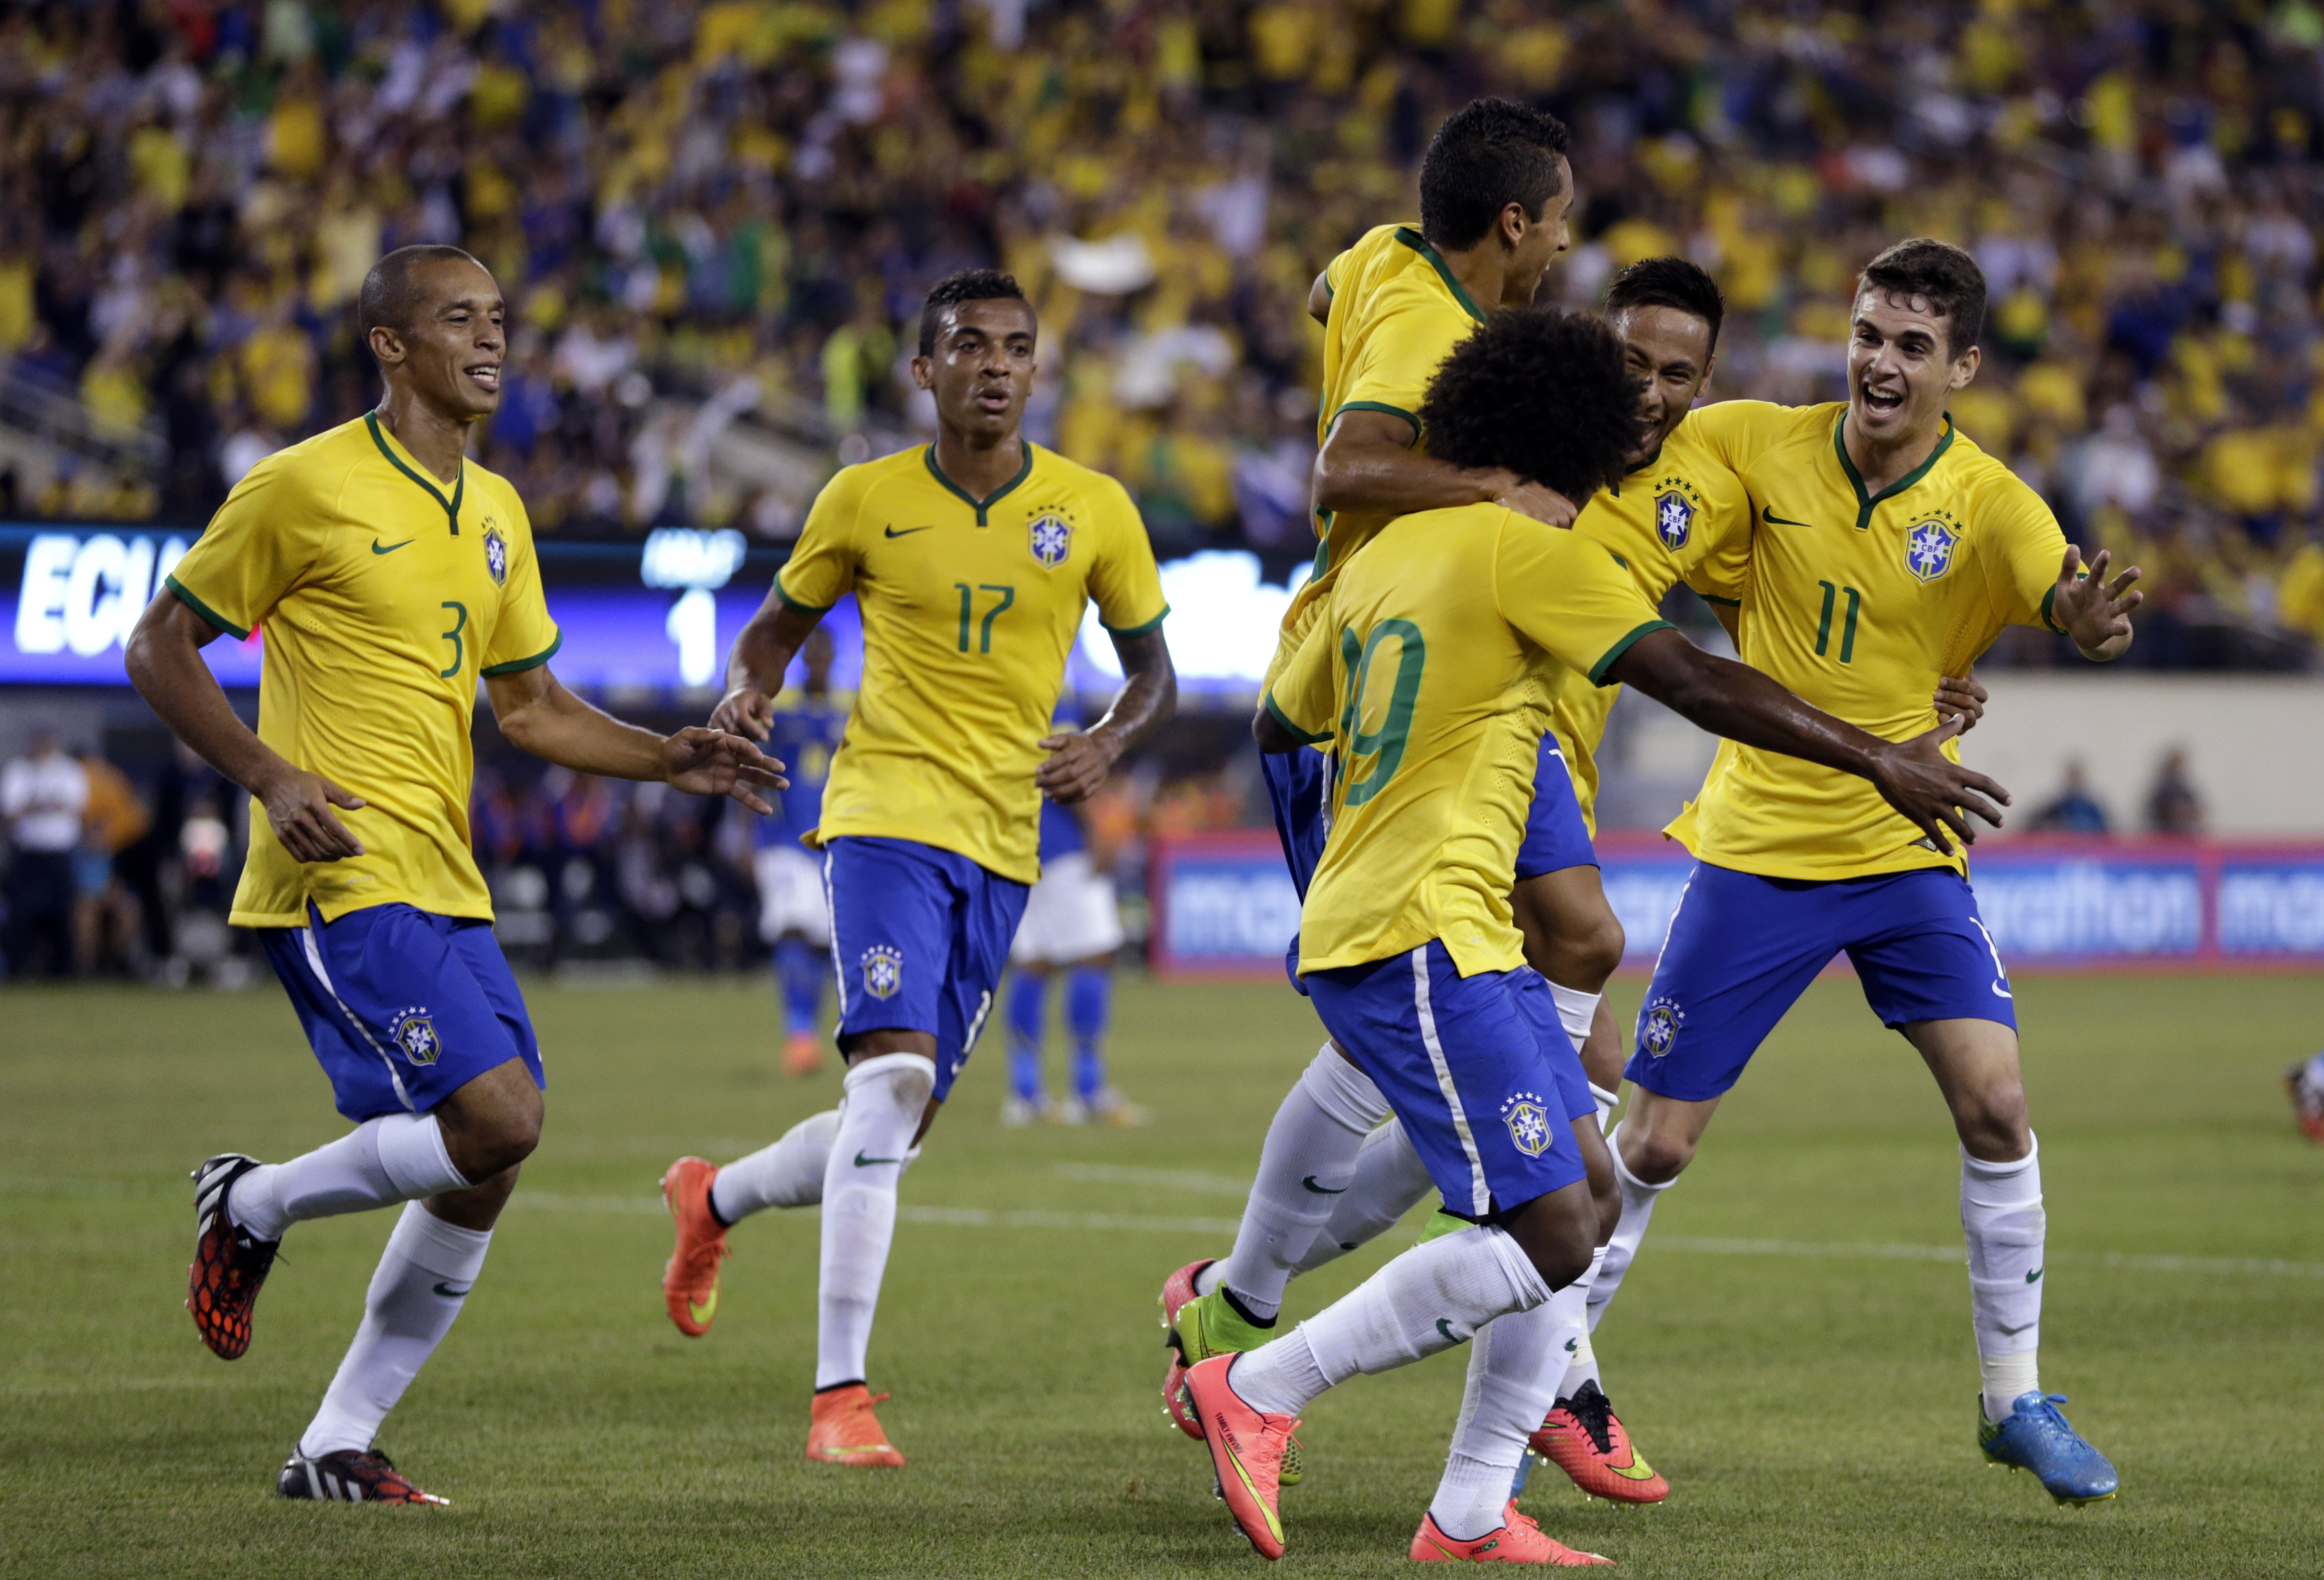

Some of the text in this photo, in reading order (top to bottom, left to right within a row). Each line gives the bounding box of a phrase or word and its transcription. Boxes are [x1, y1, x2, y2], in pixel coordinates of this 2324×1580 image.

[1668, 515, 1682, 524] CBF
[1921, 544, 1939, 553] CBF
[441, 601, 467, 678] 3
[666, 587, 716, 686] 1
[954, 583, 1015, 654] 17
[1815, 580, 1861, 664] 11
[1523, 1122, 1537, 1131] CBF
[1215, 1411, 1231, 1433] FAMILY
